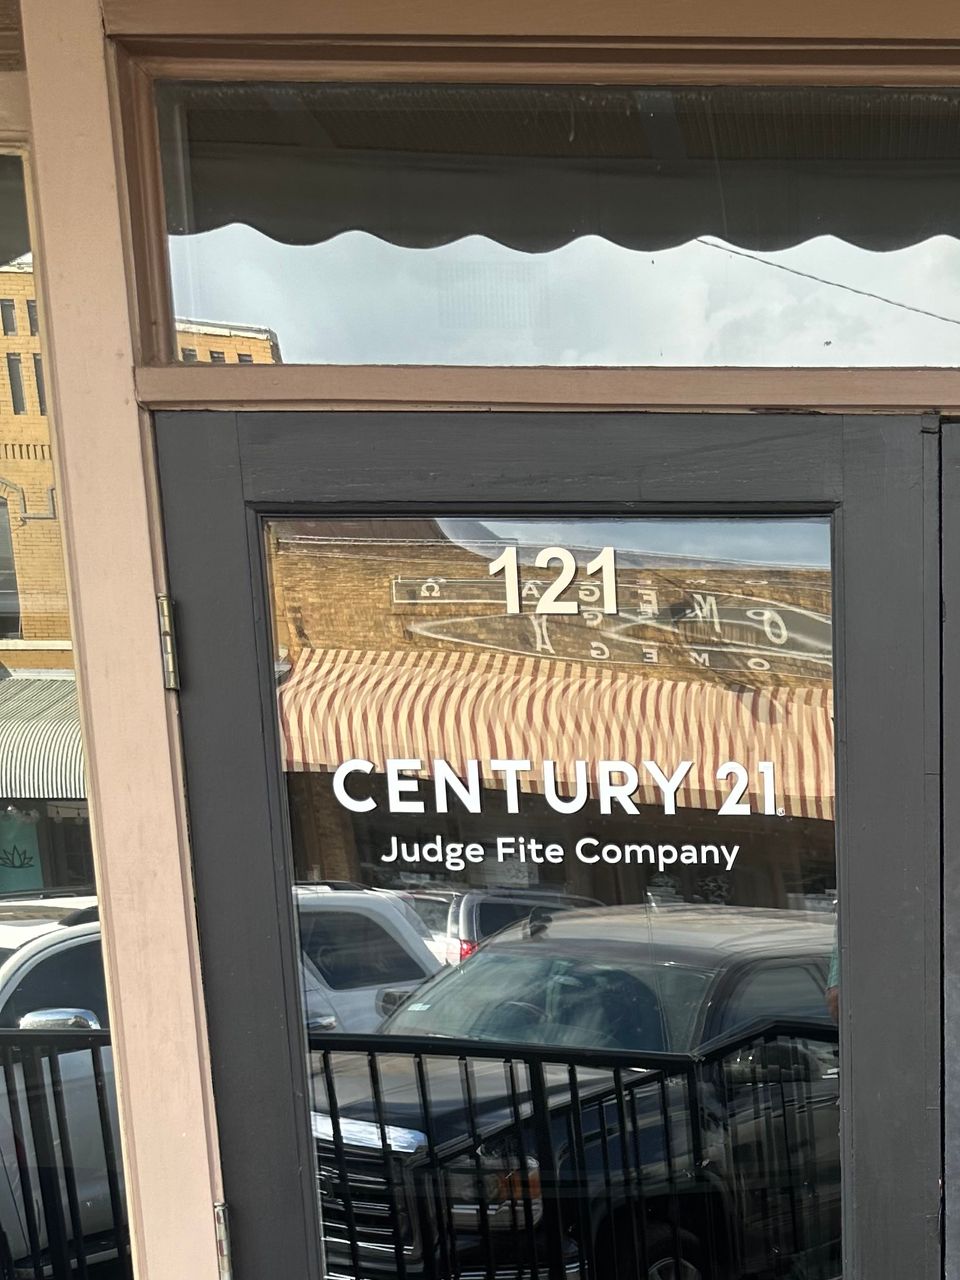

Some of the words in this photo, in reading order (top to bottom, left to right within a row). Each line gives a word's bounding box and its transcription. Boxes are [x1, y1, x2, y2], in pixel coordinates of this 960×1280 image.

[489, 546, 618, 615] 121
[332, 759, 693, 815] CENTURY
[381, 835, 485, 871] Judge
[496, 836, 564, 864] Fite
[575, 838, 740, 872] Company
